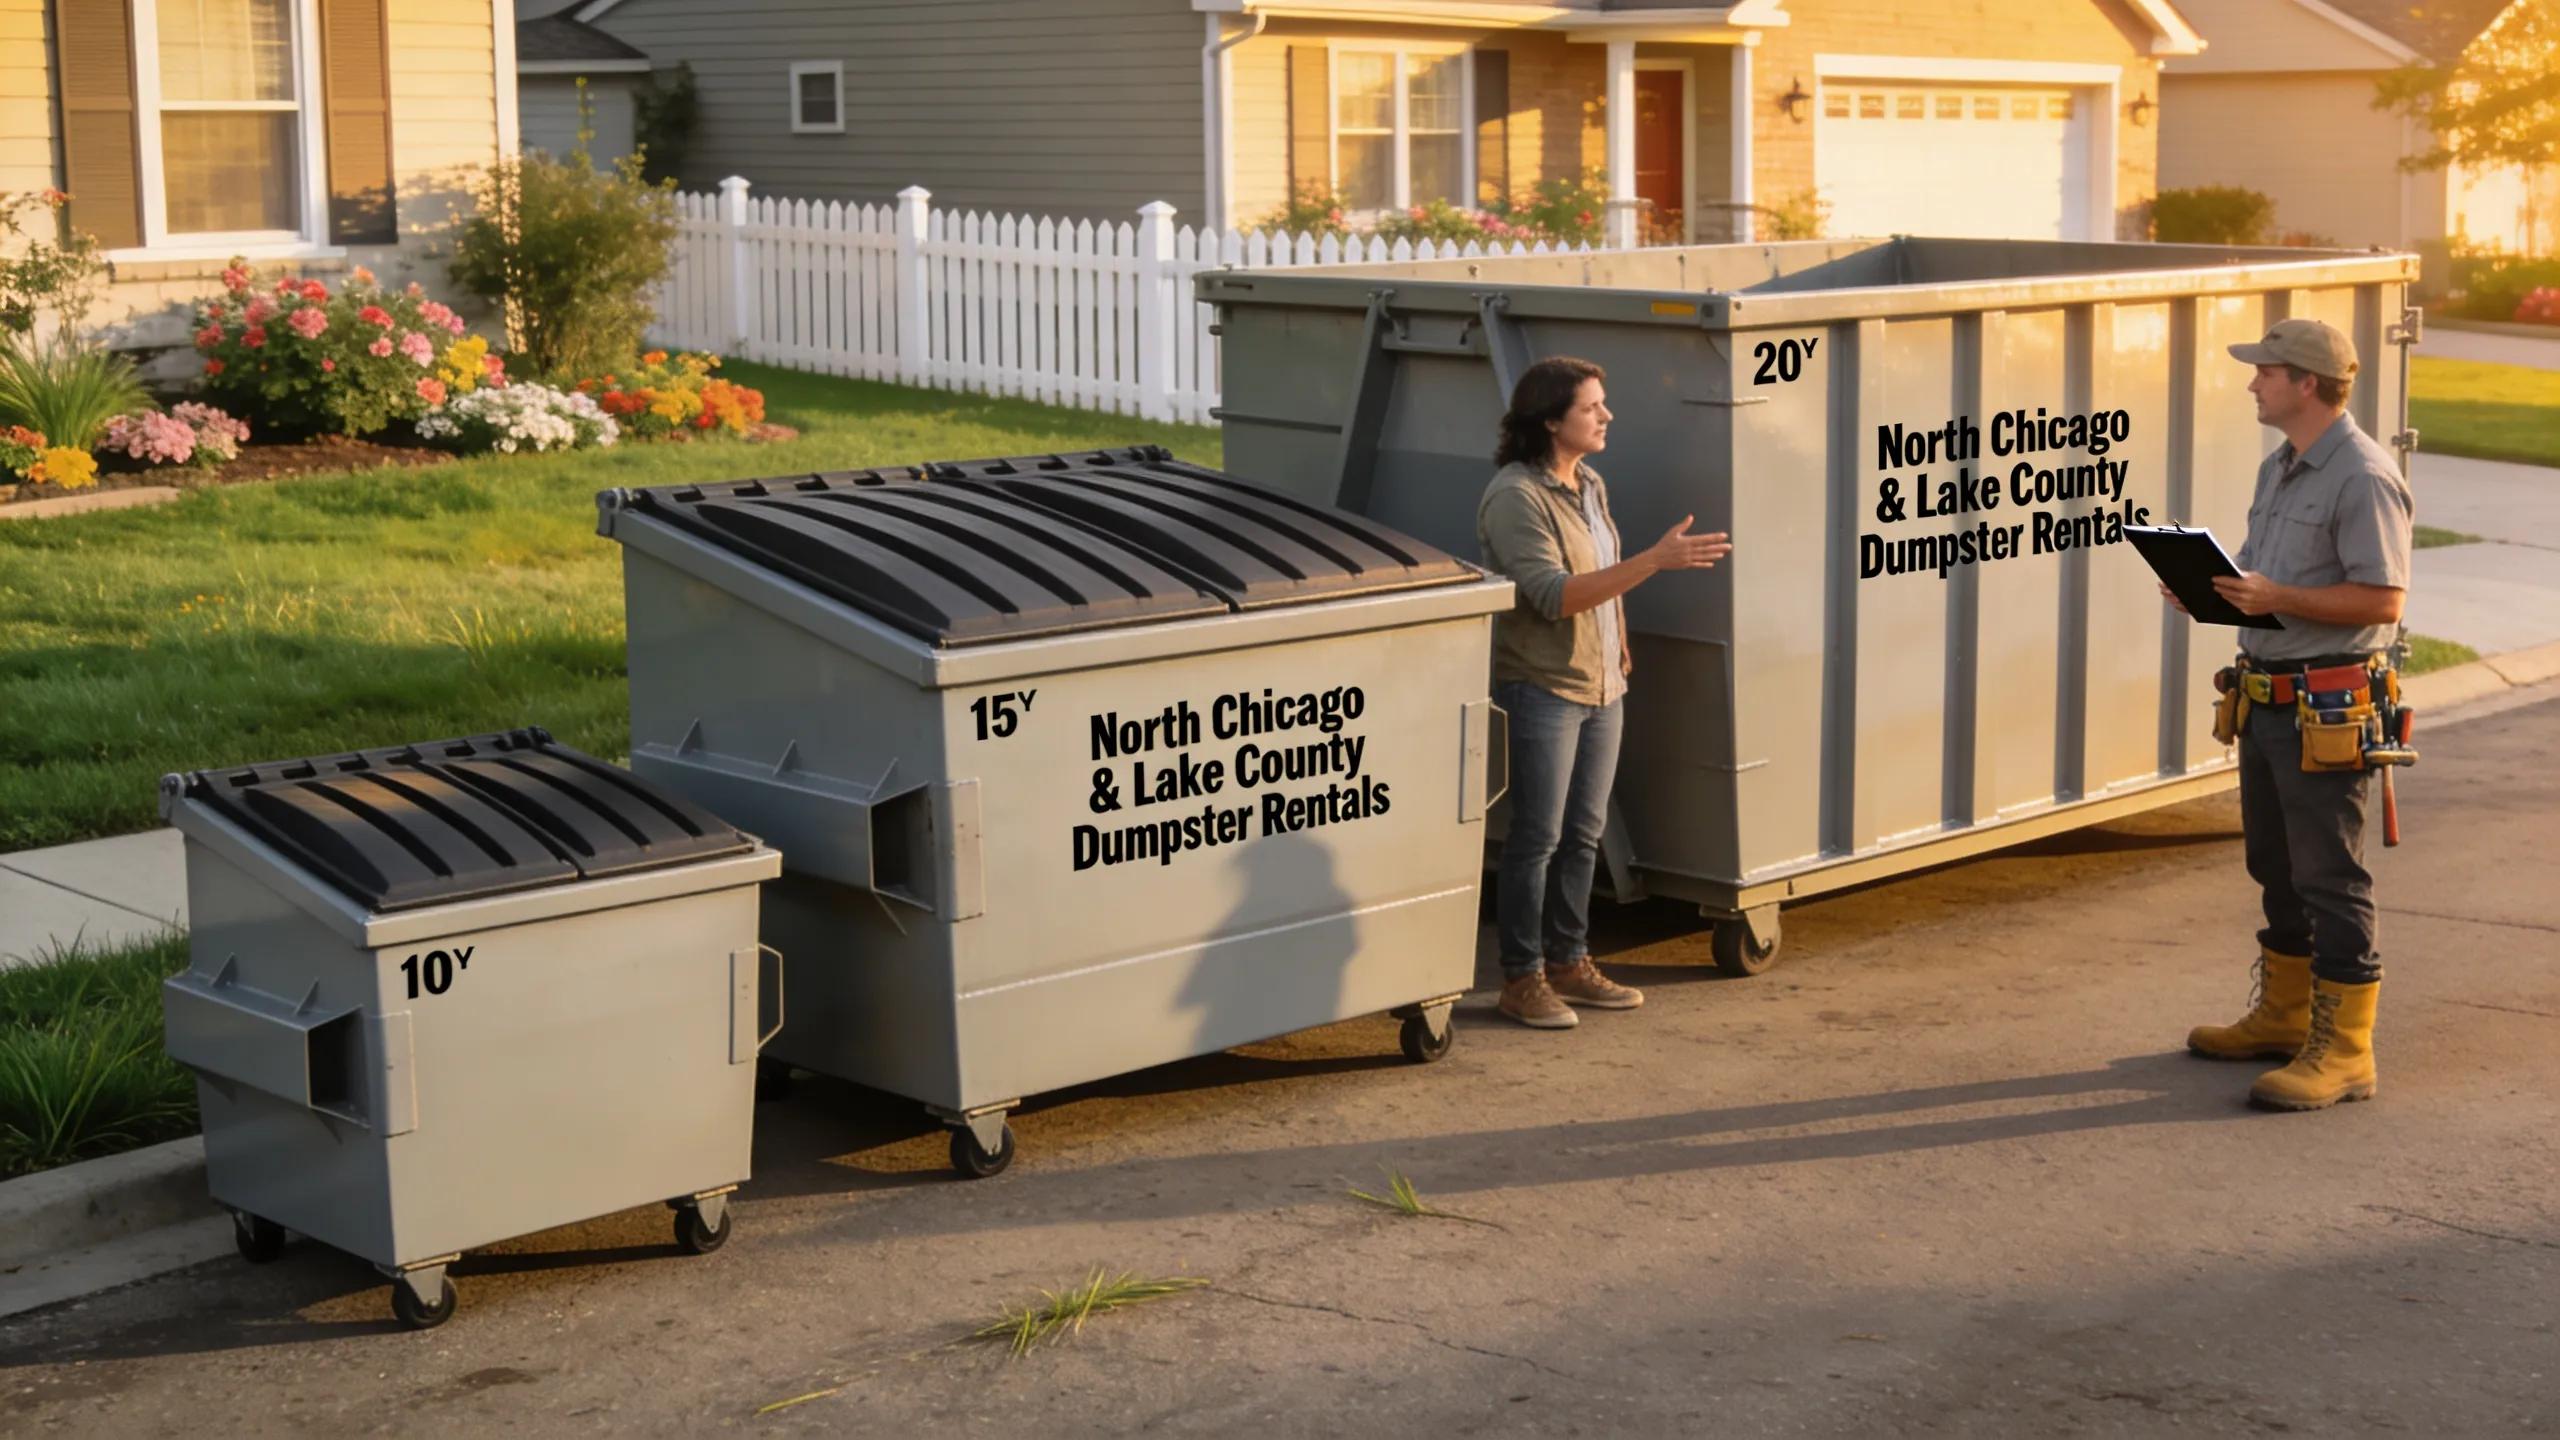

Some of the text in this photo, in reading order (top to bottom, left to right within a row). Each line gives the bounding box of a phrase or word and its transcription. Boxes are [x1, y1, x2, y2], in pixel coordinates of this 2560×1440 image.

[1878, 407, 2130, 471] North Chicago
[1876, 456, 2130, 523] & Lake County
[1860, 521, 2025, 580] Dumpster
[1090, 686, 1365, 761] North Chicago
[1089, 733, 1366, 814] & Lake County
[1072, 774, 1391, 872] Dumpster Rentals
